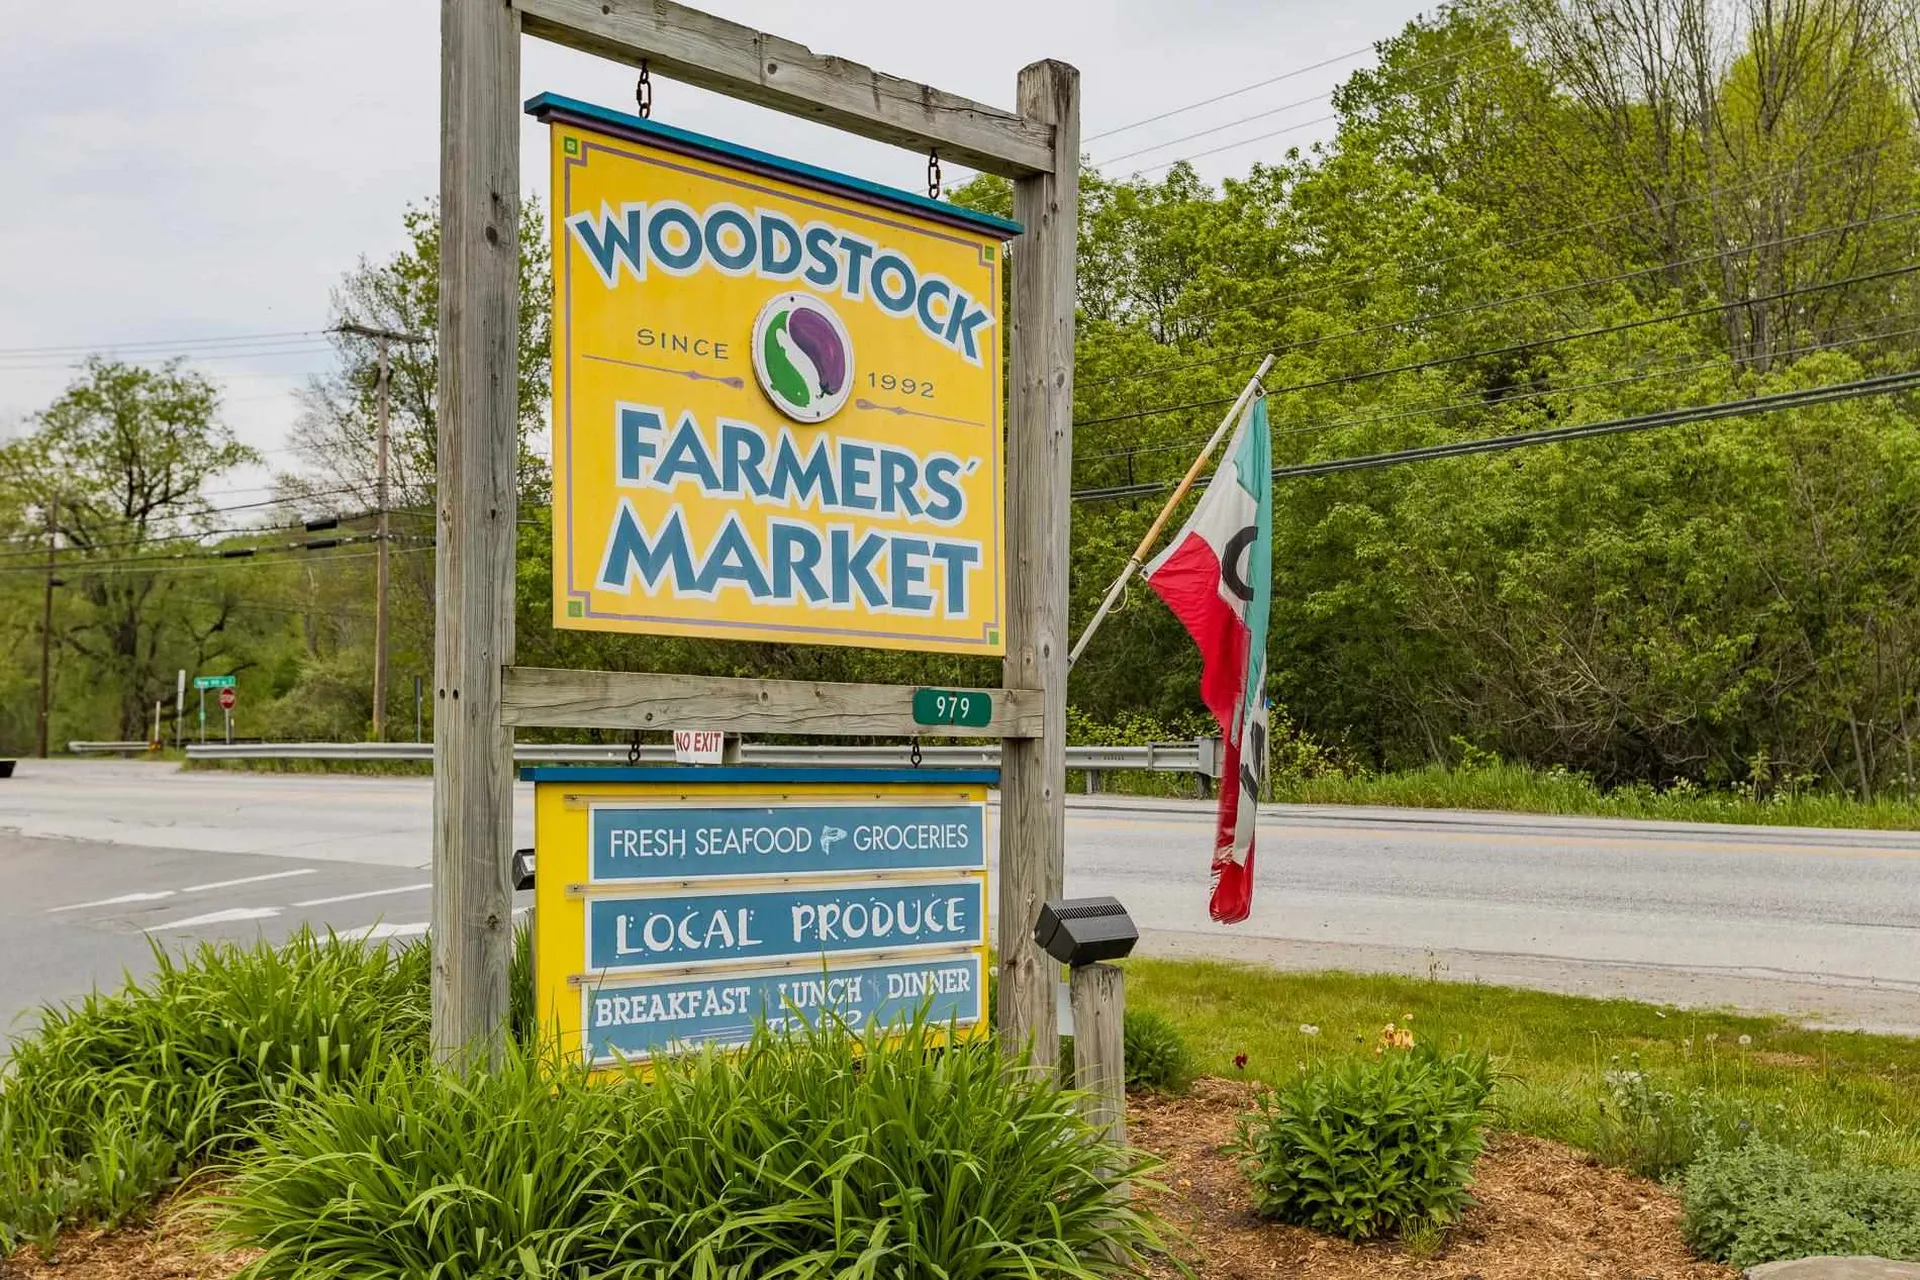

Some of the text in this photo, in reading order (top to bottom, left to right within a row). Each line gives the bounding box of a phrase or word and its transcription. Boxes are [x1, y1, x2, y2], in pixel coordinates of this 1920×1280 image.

[570, 204, 992, 363] WOODSTOCK
[637, 328, 730, 361] SINCE
[868, 371, 935, 399] 1992
[618, 405, 979, 523] FARMERS'
[599, 502, 981, 616] MARKET
[936, 695, 970, 719] 979
[674, 731, 721, 753] NO EXIT
[610, 824, 969, 859] FRESH SEAFOOD GROCERIES
[615, 897, 966, 956] LOCAL PRODUCE
[595, 967, 971, 1027] BREAKFAST LUNCH DINNER
